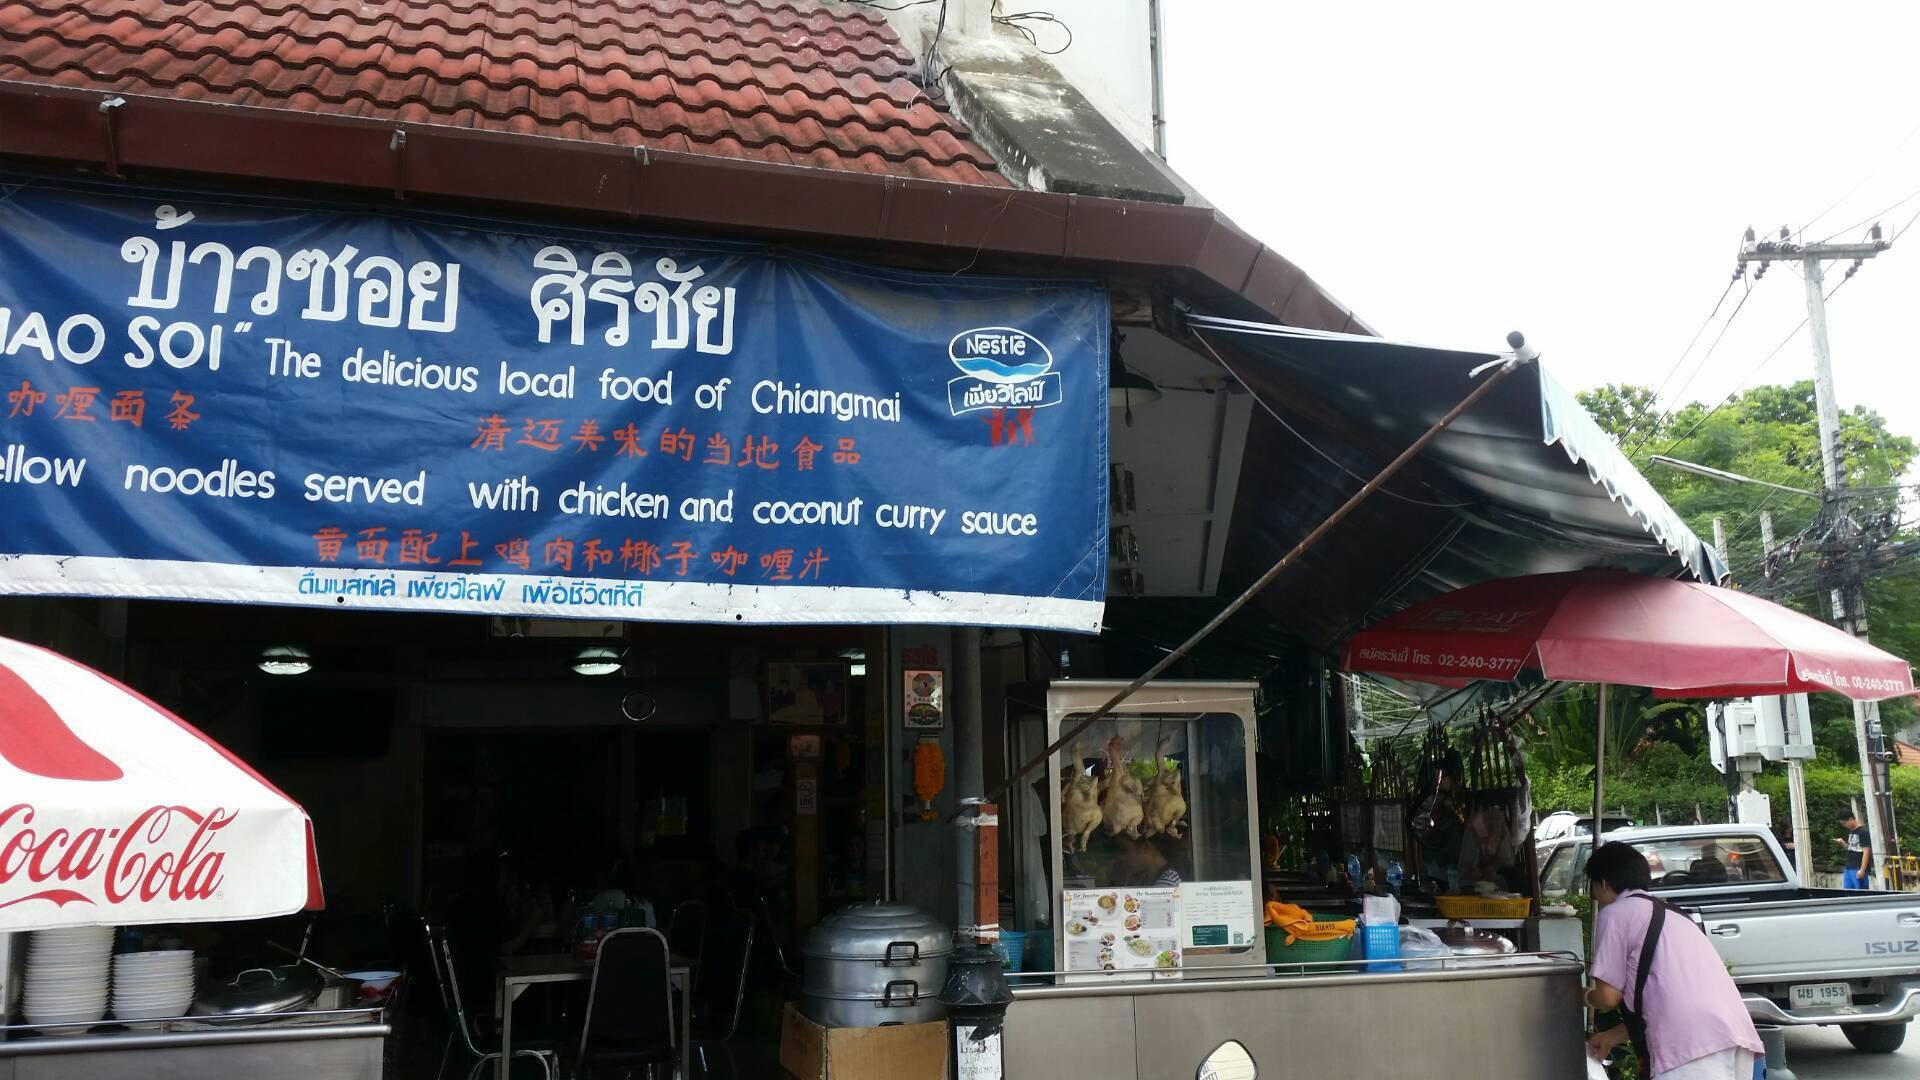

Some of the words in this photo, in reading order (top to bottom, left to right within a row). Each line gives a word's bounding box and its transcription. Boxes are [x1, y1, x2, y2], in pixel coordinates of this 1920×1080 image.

[121, 204, 461, 335] ข้าวซอย
[530, 245, 736, 355] ศิริชัย
[8, 380, 201, 431] 咖喱面条
[264, 337, 322, 378] The
[342, 346, 479, 393] delicious
[499, 361, 575, 399] local
[598, 367, 673, 406] food
[695, 377, 732, 412] of
[751, 379, 901, 423] Chiangmai
[471, 415, 862, 471] 清迈美味的当地食品
[124, 458, 276, 499] noodles
[304, 470, 426, 506] served
[468, 477, 539, 512] with
[558, 482, 669, 519] chicken
[680, 489, 733, 523] and
[752, 496, 864, 526] coconut
[876, 508, 947, 535] curry
[961, 510, 1038, 536] sauce
[312, 526, 830, 582] 黄面配上鸡肉和椰子咖喱汁
[1438, 653, 1521, 671] 02-240-3777
[1864, 939, 1920, 954] ISUZ
[1819, 986, 1846, 998] 1953
